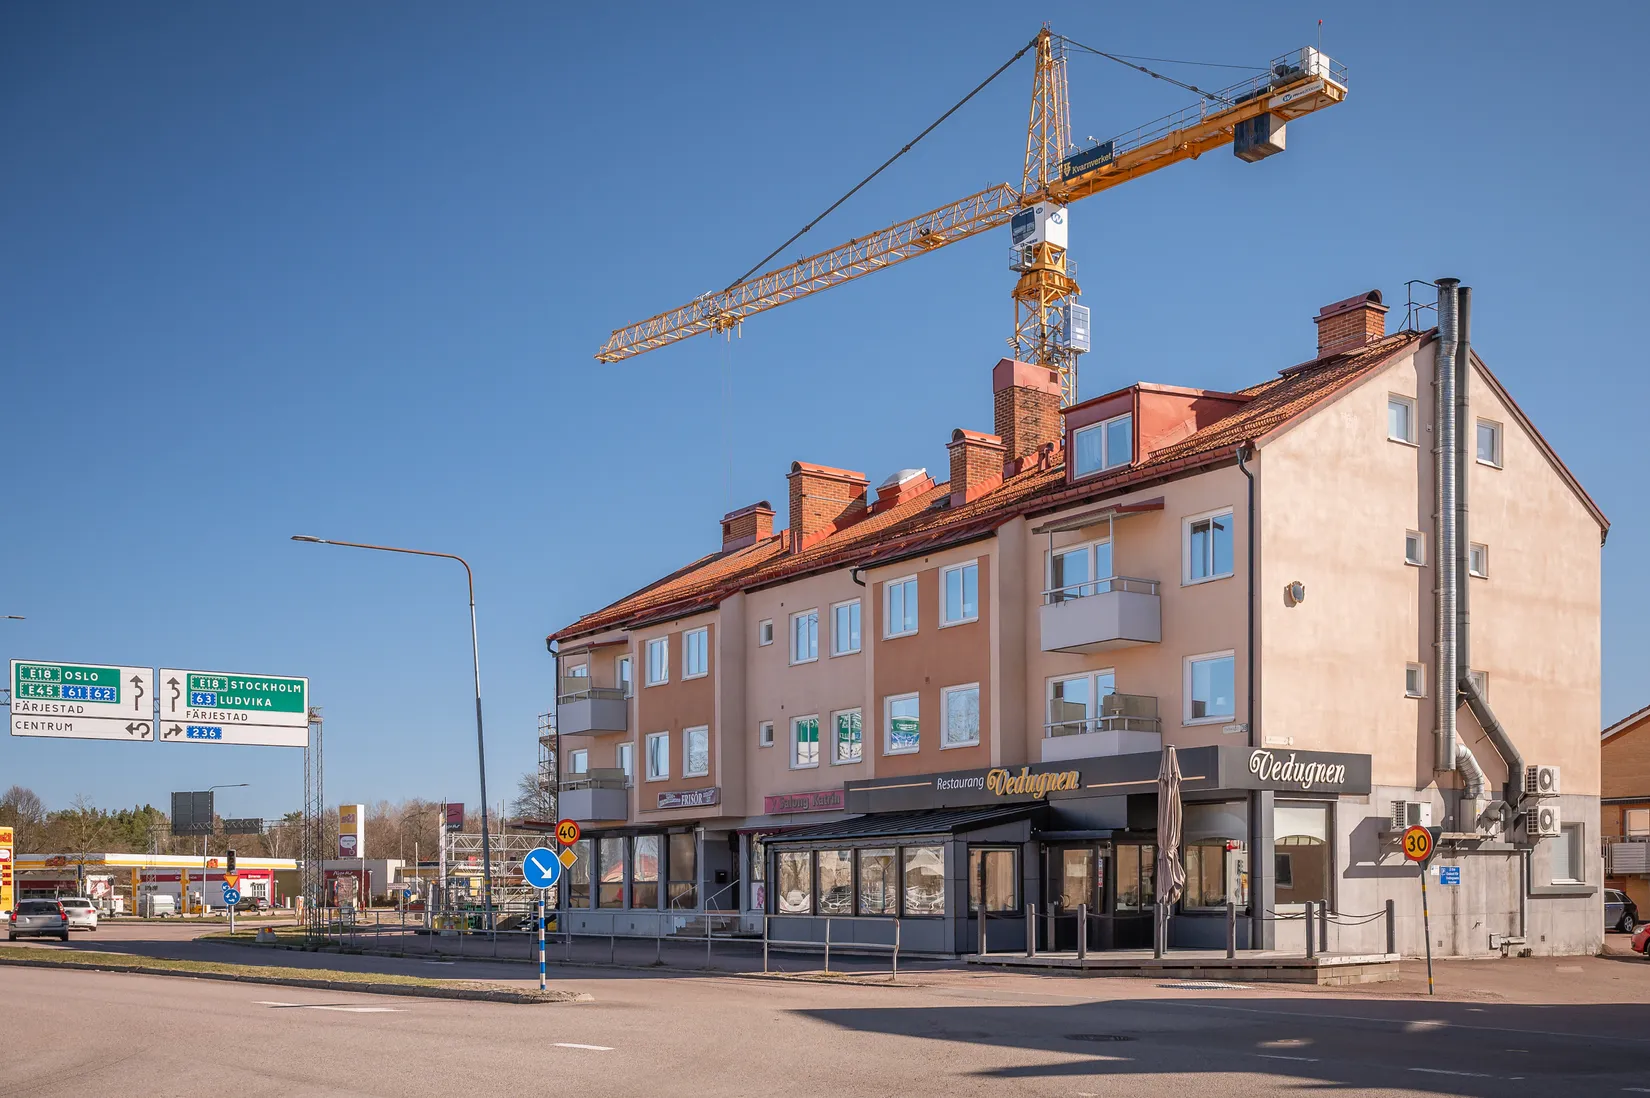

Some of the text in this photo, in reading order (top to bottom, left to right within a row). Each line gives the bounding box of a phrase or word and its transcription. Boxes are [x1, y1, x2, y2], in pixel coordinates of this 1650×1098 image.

[1071, 152, 1112, 174] Kvarnverket
[29, 669, 99, 681] E18 OSLO
[28, 685, 111, 698] E45 61 62
[199, 679, 301, 693] E18 STOCKHOLM
[15, 700, 84, 714] FÄRJESTAD
[196, 694, 272, 707] 63 LUDVIKA
[186, 708, 248, 721] FÄRJESTAD
[15, 721, 73, 731] CENTRUM
[192, 728, 216, 737] 236
[1249, 749, 1345, 789] Vedugnen
[937, 766, 1080, 799] Restaurang Vedugnen
[681, 791, 703, 805] FRISÖR
[779, 792, 841, 810] Salong Katrin
[559, 826, 576, 839] 40
[1407, 835, 1427, 852] 30
